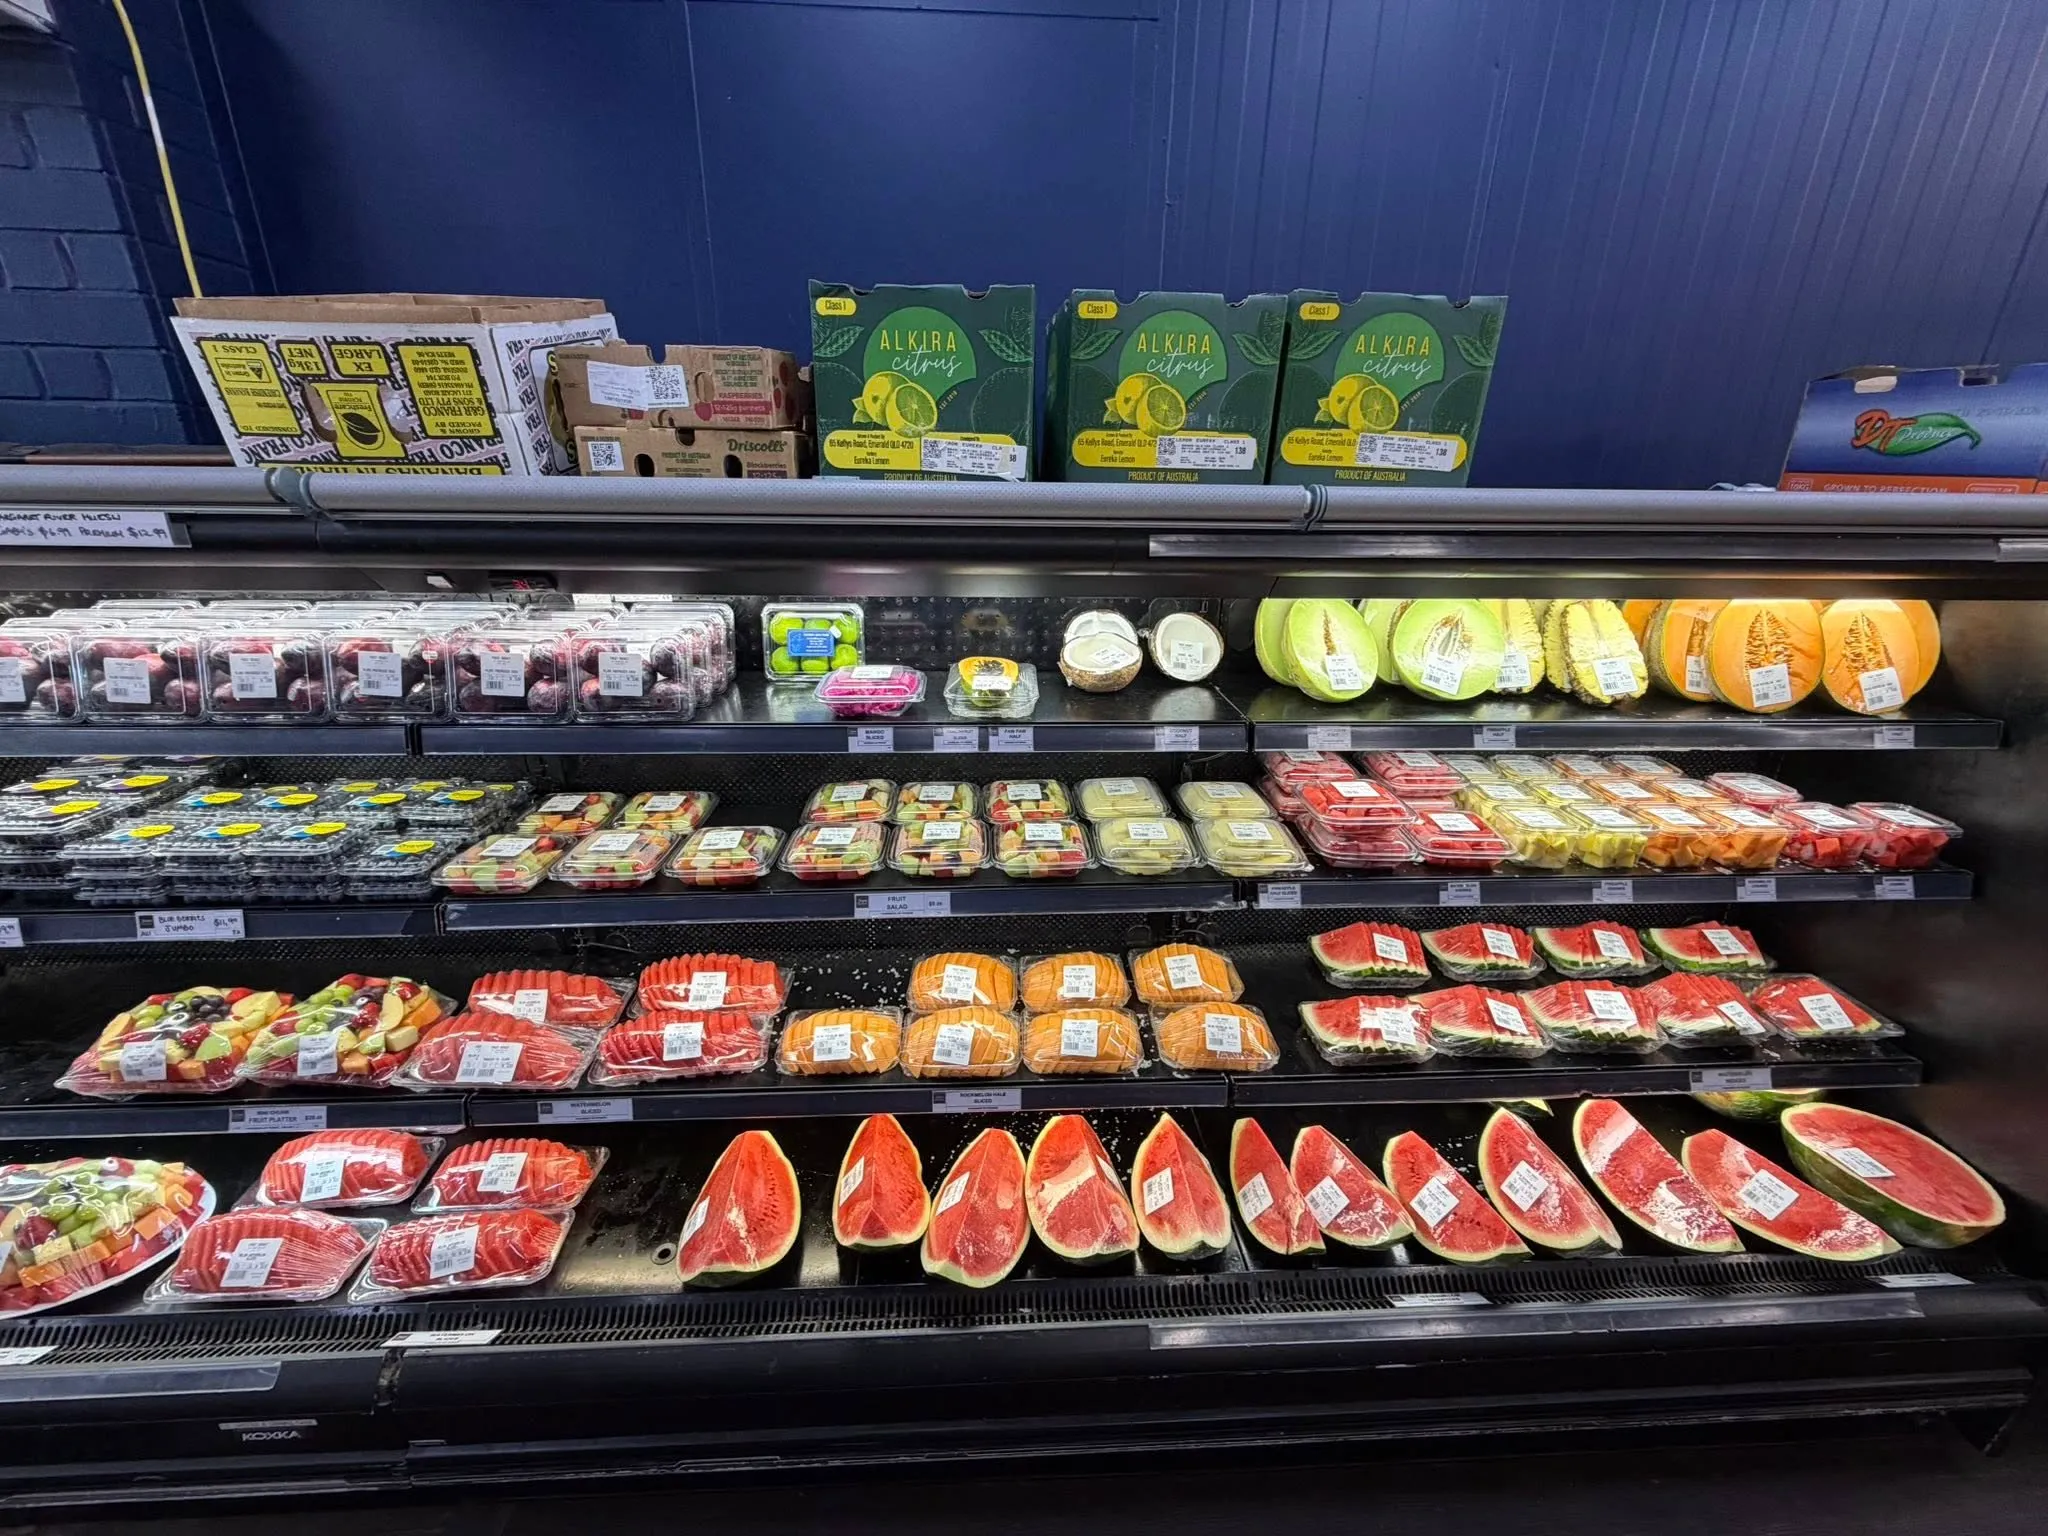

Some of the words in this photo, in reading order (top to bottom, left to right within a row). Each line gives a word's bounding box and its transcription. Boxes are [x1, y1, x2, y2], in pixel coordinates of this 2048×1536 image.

[825, 300, 842, 311] Class
[1087, 303, 1104, 314] Class
[880, 330, 957, 352] ALKIRA
[1137, 332, 1210, 354] ALKIRA
[1355, 334, 1431, 356] ALKIRA
[222, 346, 257, 354] CLASS
[288, 348, 312, 358] NET
[334, 348, 382, 359] LARGE
[288, 359, 320, 371] 13kg
[892, 345, 962, 377] citrus
[1147, 348, 1214, 379] citrus
[1363, 348, 1431, 380] citrus
[352, 362, 373, 372] EX
[422, 406, 462, 416] FRANCO
[463, 406, 485, 416] G&R
[1148, 440, 1158, 448] 472
[1436, 448, 1448, 456] 138
[1128, 471, 1156, 480] PRODUCT
[1157, 472, 1166, 480] OF
[1166, 472, 1199, 482] AUSTRALIA
[1334, 469, 1364, 480] PRODUCT
[1364, 470, 1372, 480] OF
[1374, 470, 1406, 481] AUSTRALIA
[0, 512, 41, 522] ARGARET
[128, 526, 168, 539] $12.99
